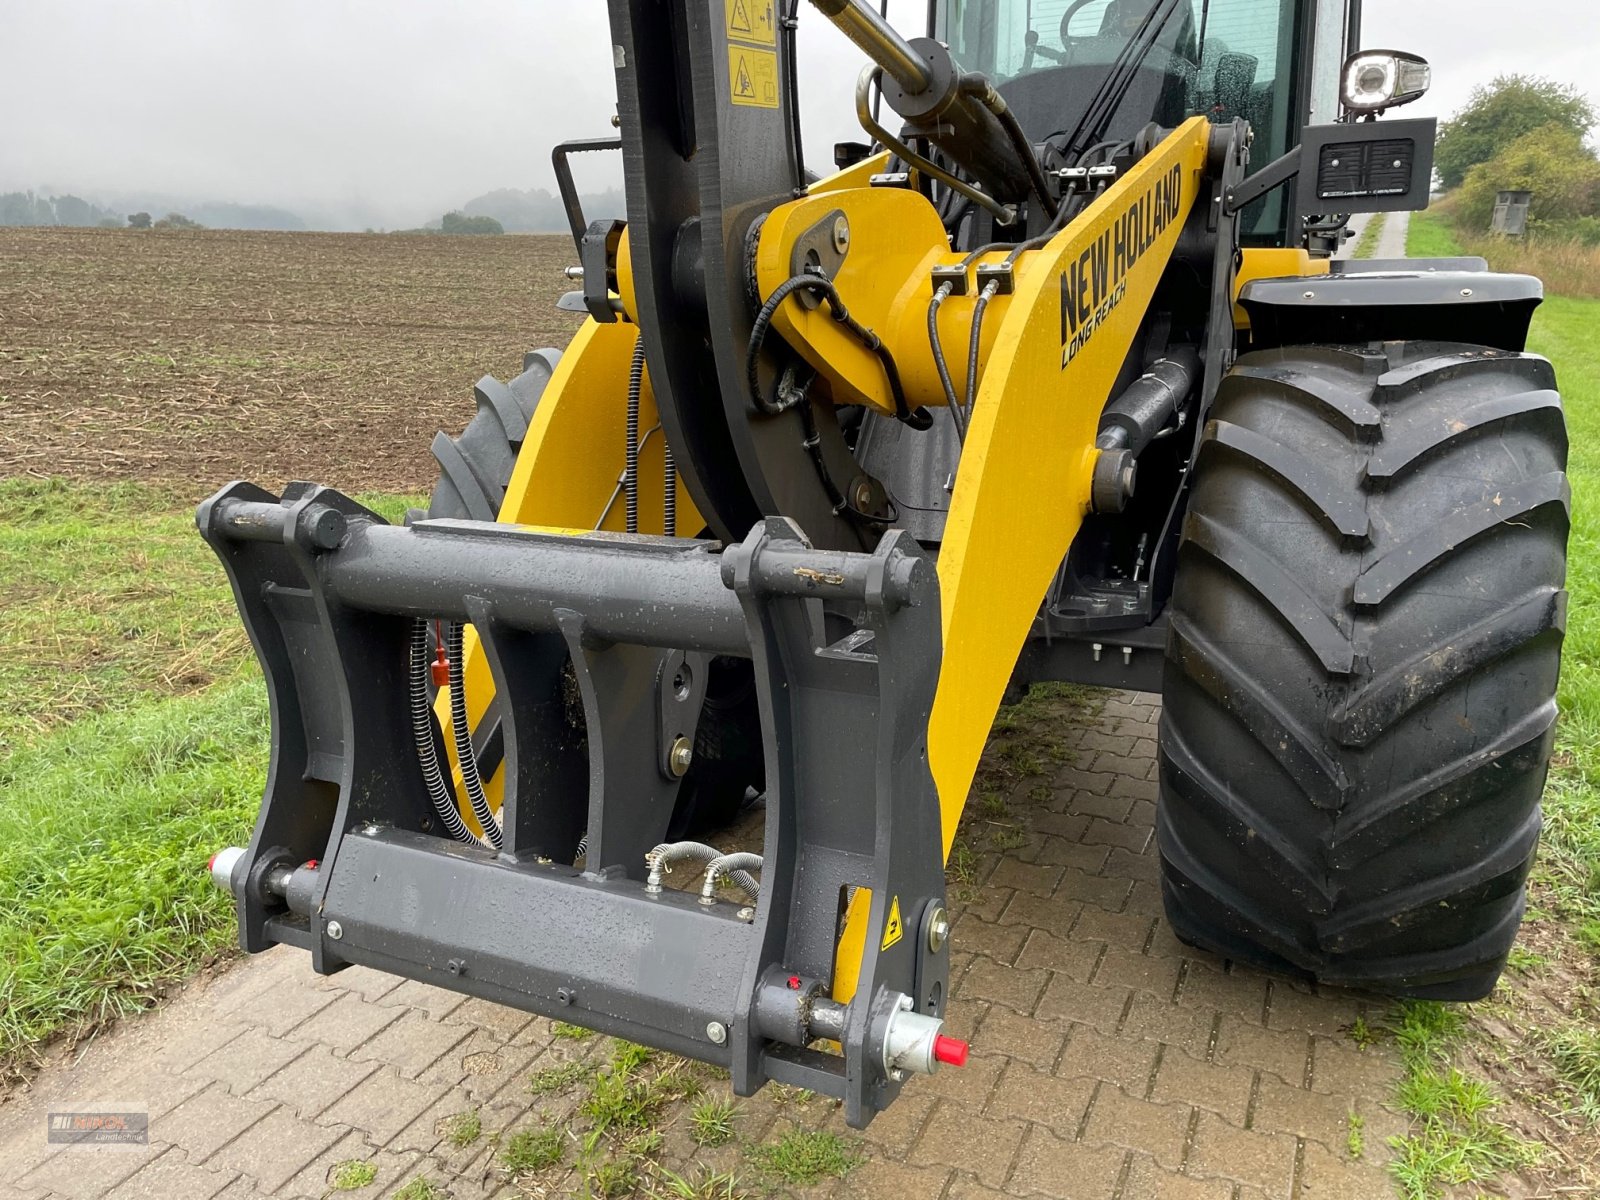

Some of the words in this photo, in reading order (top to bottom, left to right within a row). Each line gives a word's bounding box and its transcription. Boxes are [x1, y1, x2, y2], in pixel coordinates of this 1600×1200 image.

[1060, 228, 1110, 346] NEW
[1113, 163, 1181, 286] HOLLAND
[1061, 319, 1093, 371] LONG
[1094, 278, 1126, 332] REACH
